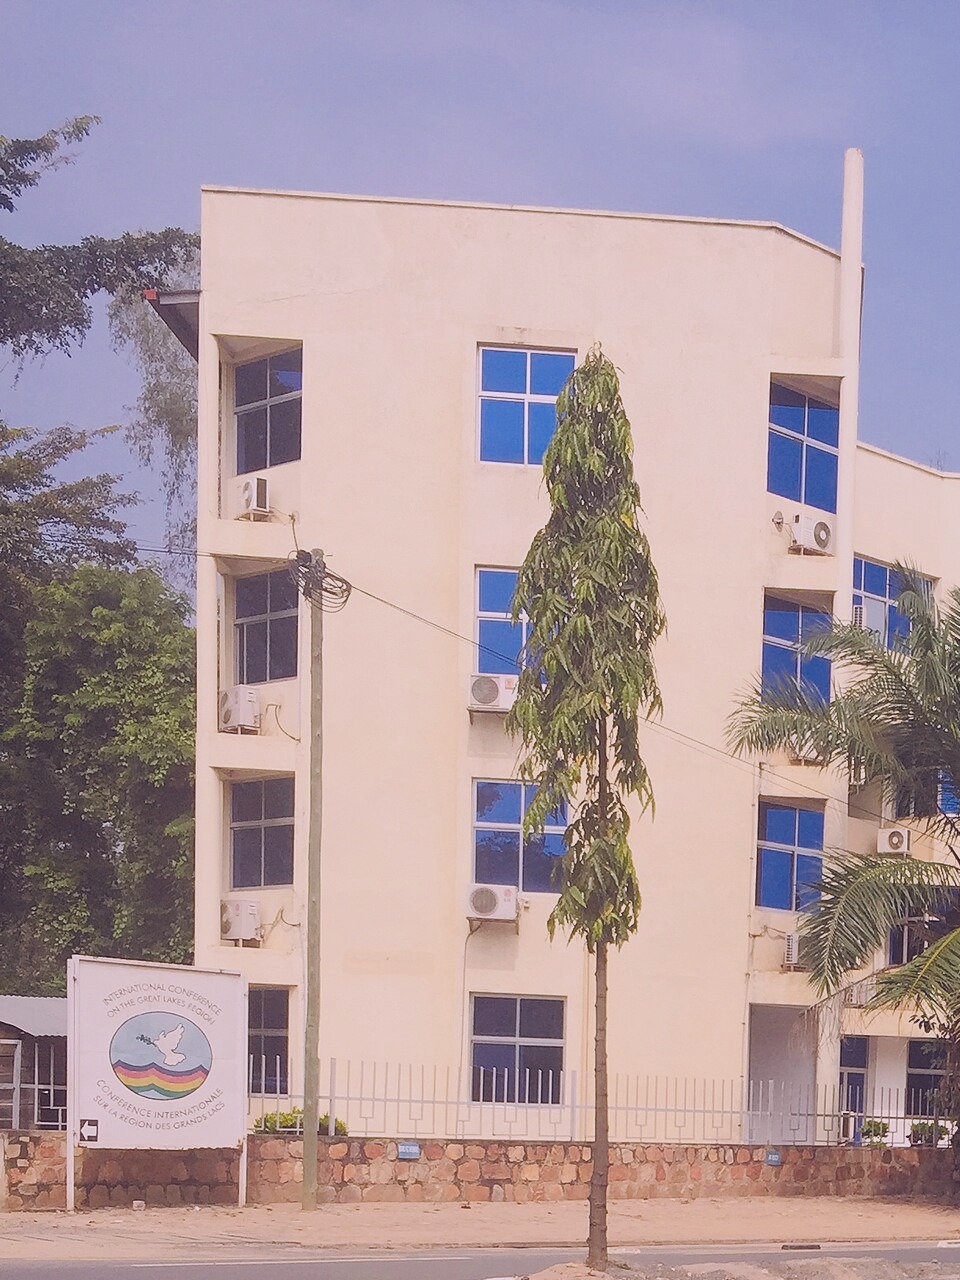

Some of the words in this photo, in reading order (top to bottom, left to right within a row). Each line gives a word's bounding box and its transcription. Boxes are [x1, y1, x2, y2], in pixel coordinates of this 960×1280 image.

[103, 983, 166, 1006] INTERNATIONAL
[168, 984, 222, 1016] CONFERENCE
[107, 1007, 120, 1018] ON
[120, 1000, 136, 1009] THE
[137, 995, 161, 1004] GREAT
[163, 996, 186, 1008] LAKES
[187, 1003, 216, 1025] REGION
[93, 1095, 109, 1109] SUR
[108, 1107, 118, 1118] LA
[173, 1114, 208, 1130] GRANDS
[209, 1101, 225, 1118] LACS
[96, 1079, 151, 1118] CONFERENCE
[154, 1088, 224, 1119] INTERNATIONALE
